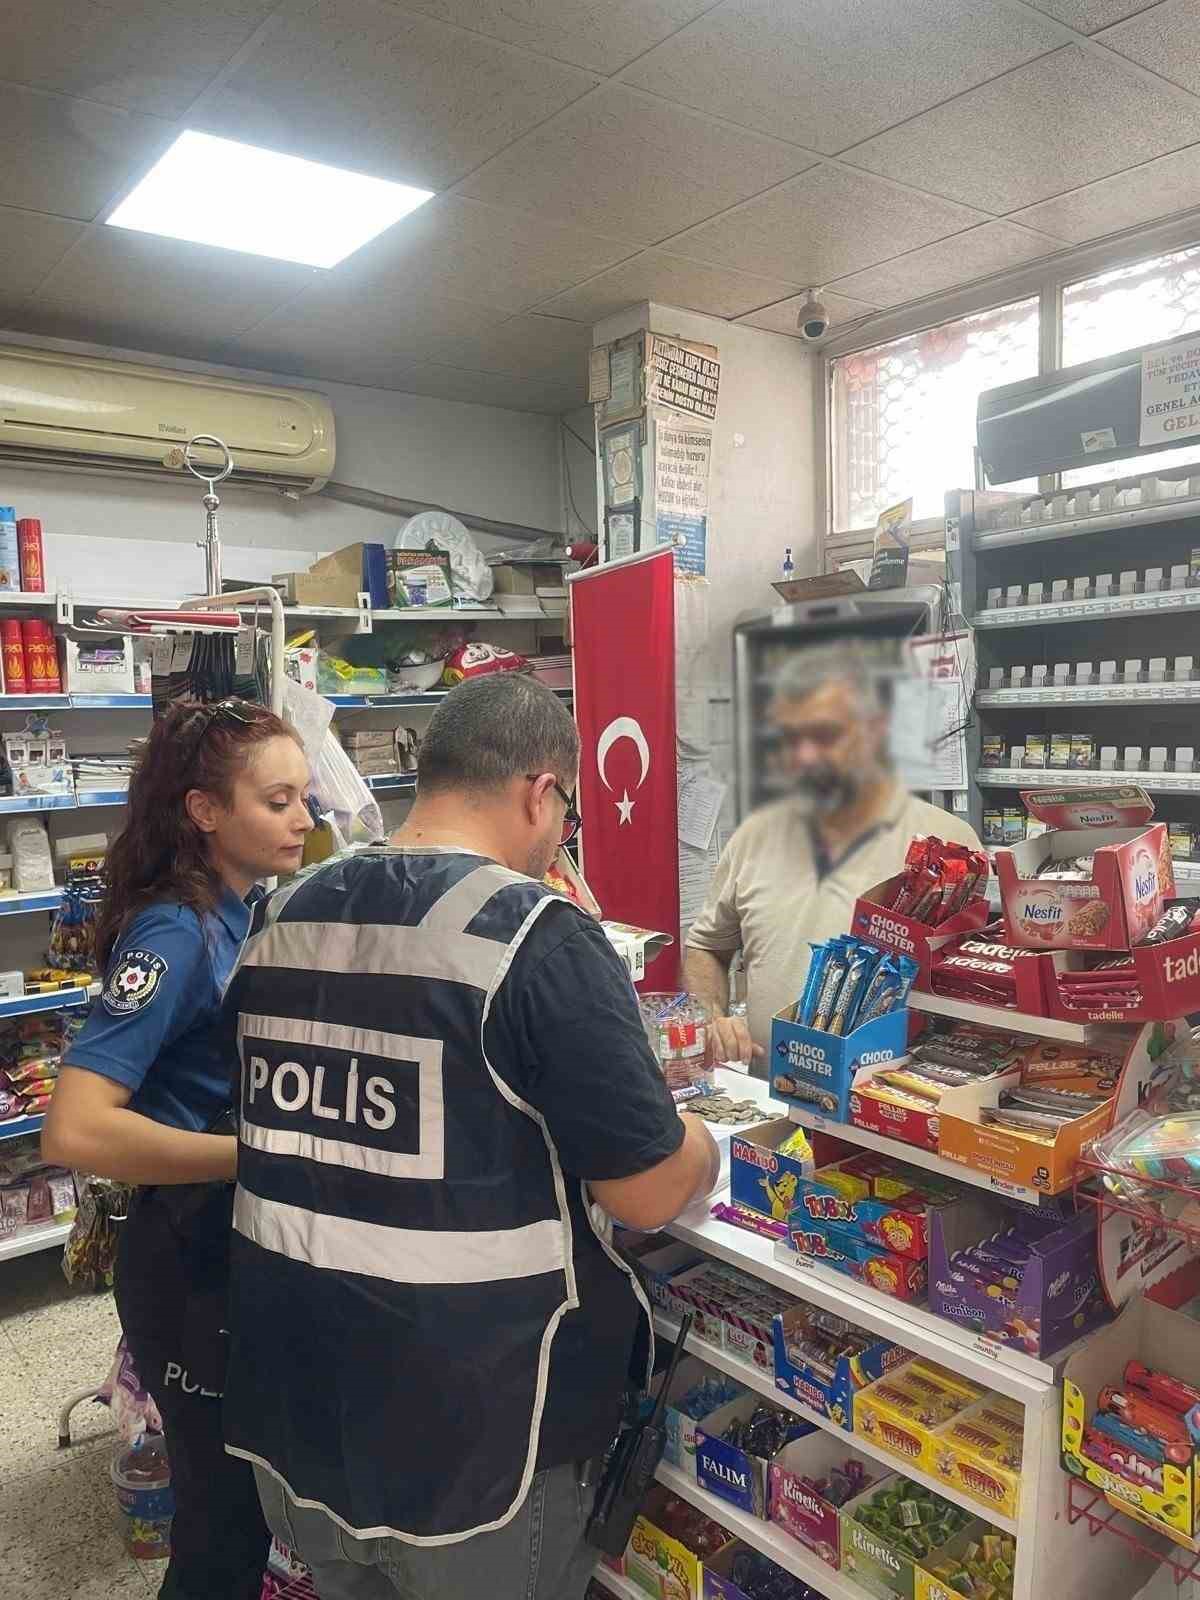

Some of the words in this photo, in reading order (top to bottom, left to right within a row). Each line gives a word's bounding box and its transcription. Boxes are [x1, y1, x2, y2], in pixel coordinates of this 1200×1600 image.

[1146, 398, 1186, 415] GENEL
[1135, 872, 1156, 900] Nesfit
[1024, 904, 1063, 920] Nesfit
[871, 914, 909, 937] CHOCO
[868, 925, 915, 953] MASTER
[1163, 948, 1200, 983] tad
[1088, 1010, 1124, 1021] tadelle
[789, 1040, 826, 1060] CHOCO
[860, 1049, 894, 1065] CHOCO
[788, 1055, 832, 1077] MASTER
[249, 1056, 397, 1130] POLİS
[733, 1142, 778, 1173] HARIBO
[701, 1455, 748, 1488] FALIM
[852, 1530, 900, 1571] Kinetics
